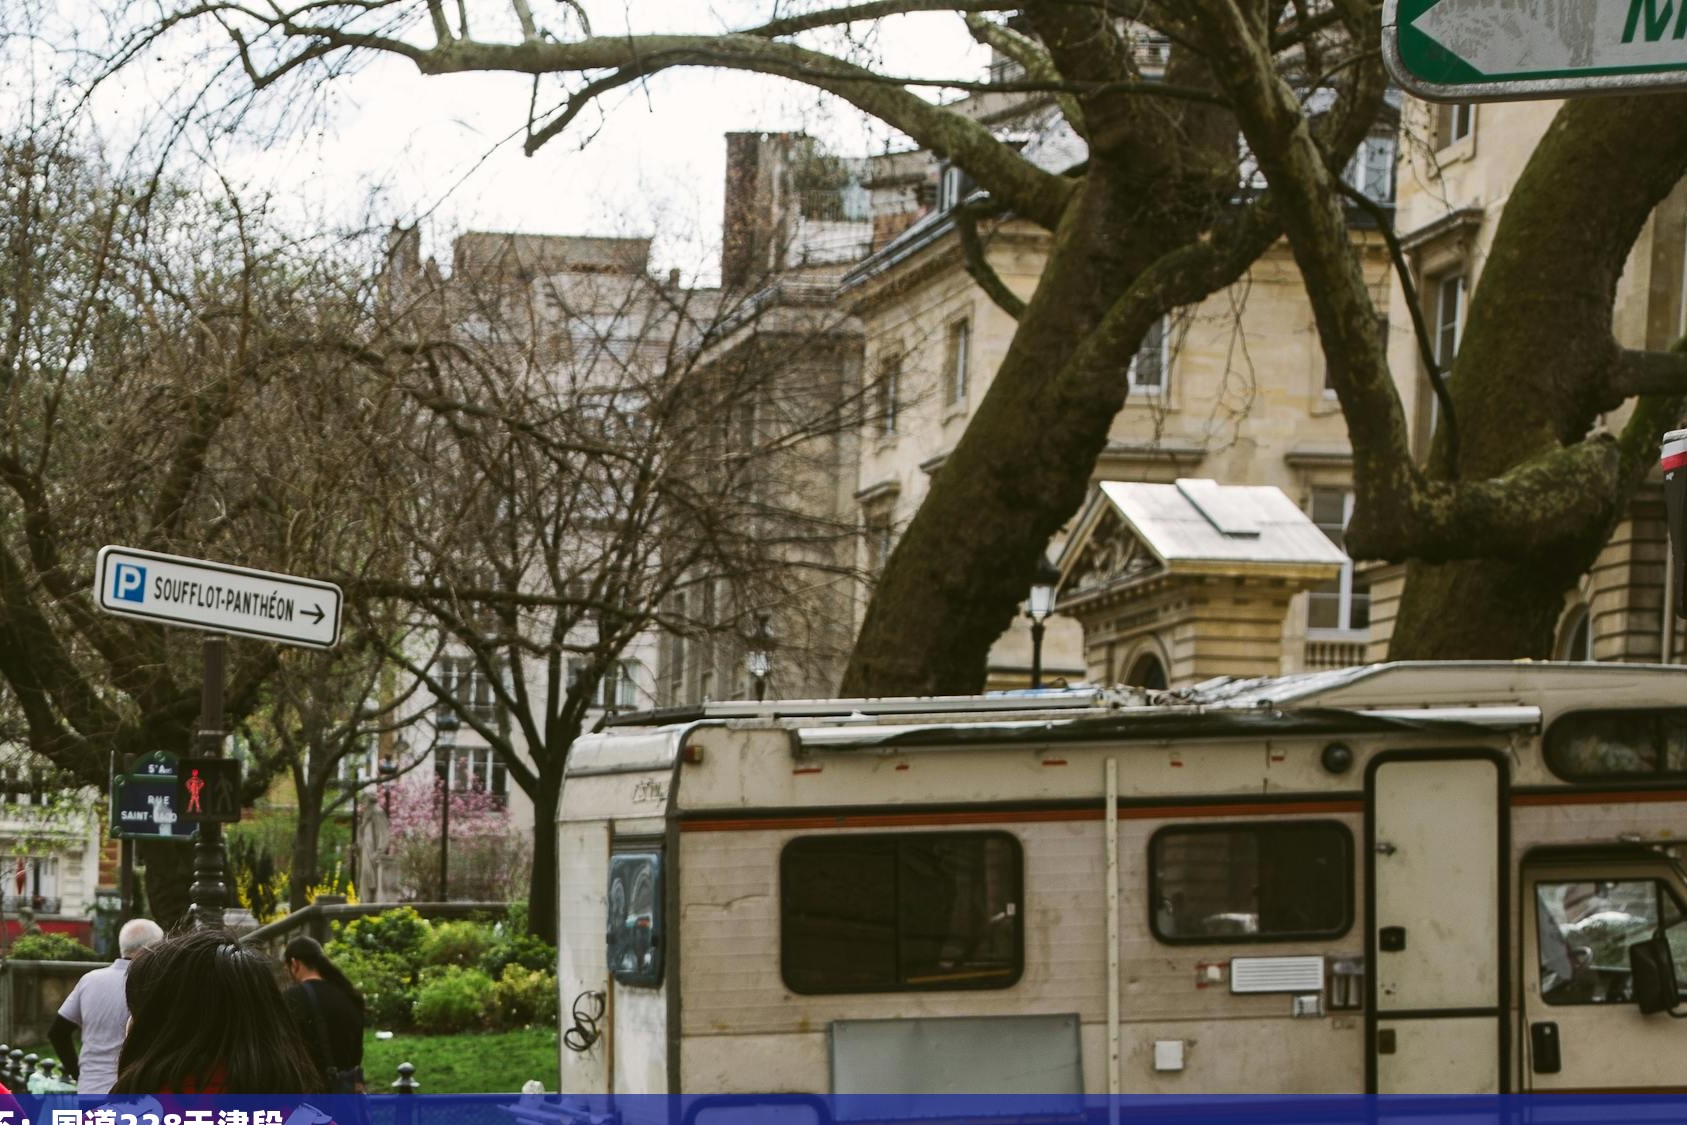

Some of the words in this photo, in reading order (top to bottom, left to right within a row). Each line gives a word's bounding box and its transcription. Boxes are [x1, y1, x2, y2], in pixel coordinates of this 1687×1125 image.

[117, 565, 142, 599] P
[154, 576, 295, 622] SOUFFLOT-PANTHÉON
[148, 795, 170, 805] RUE
